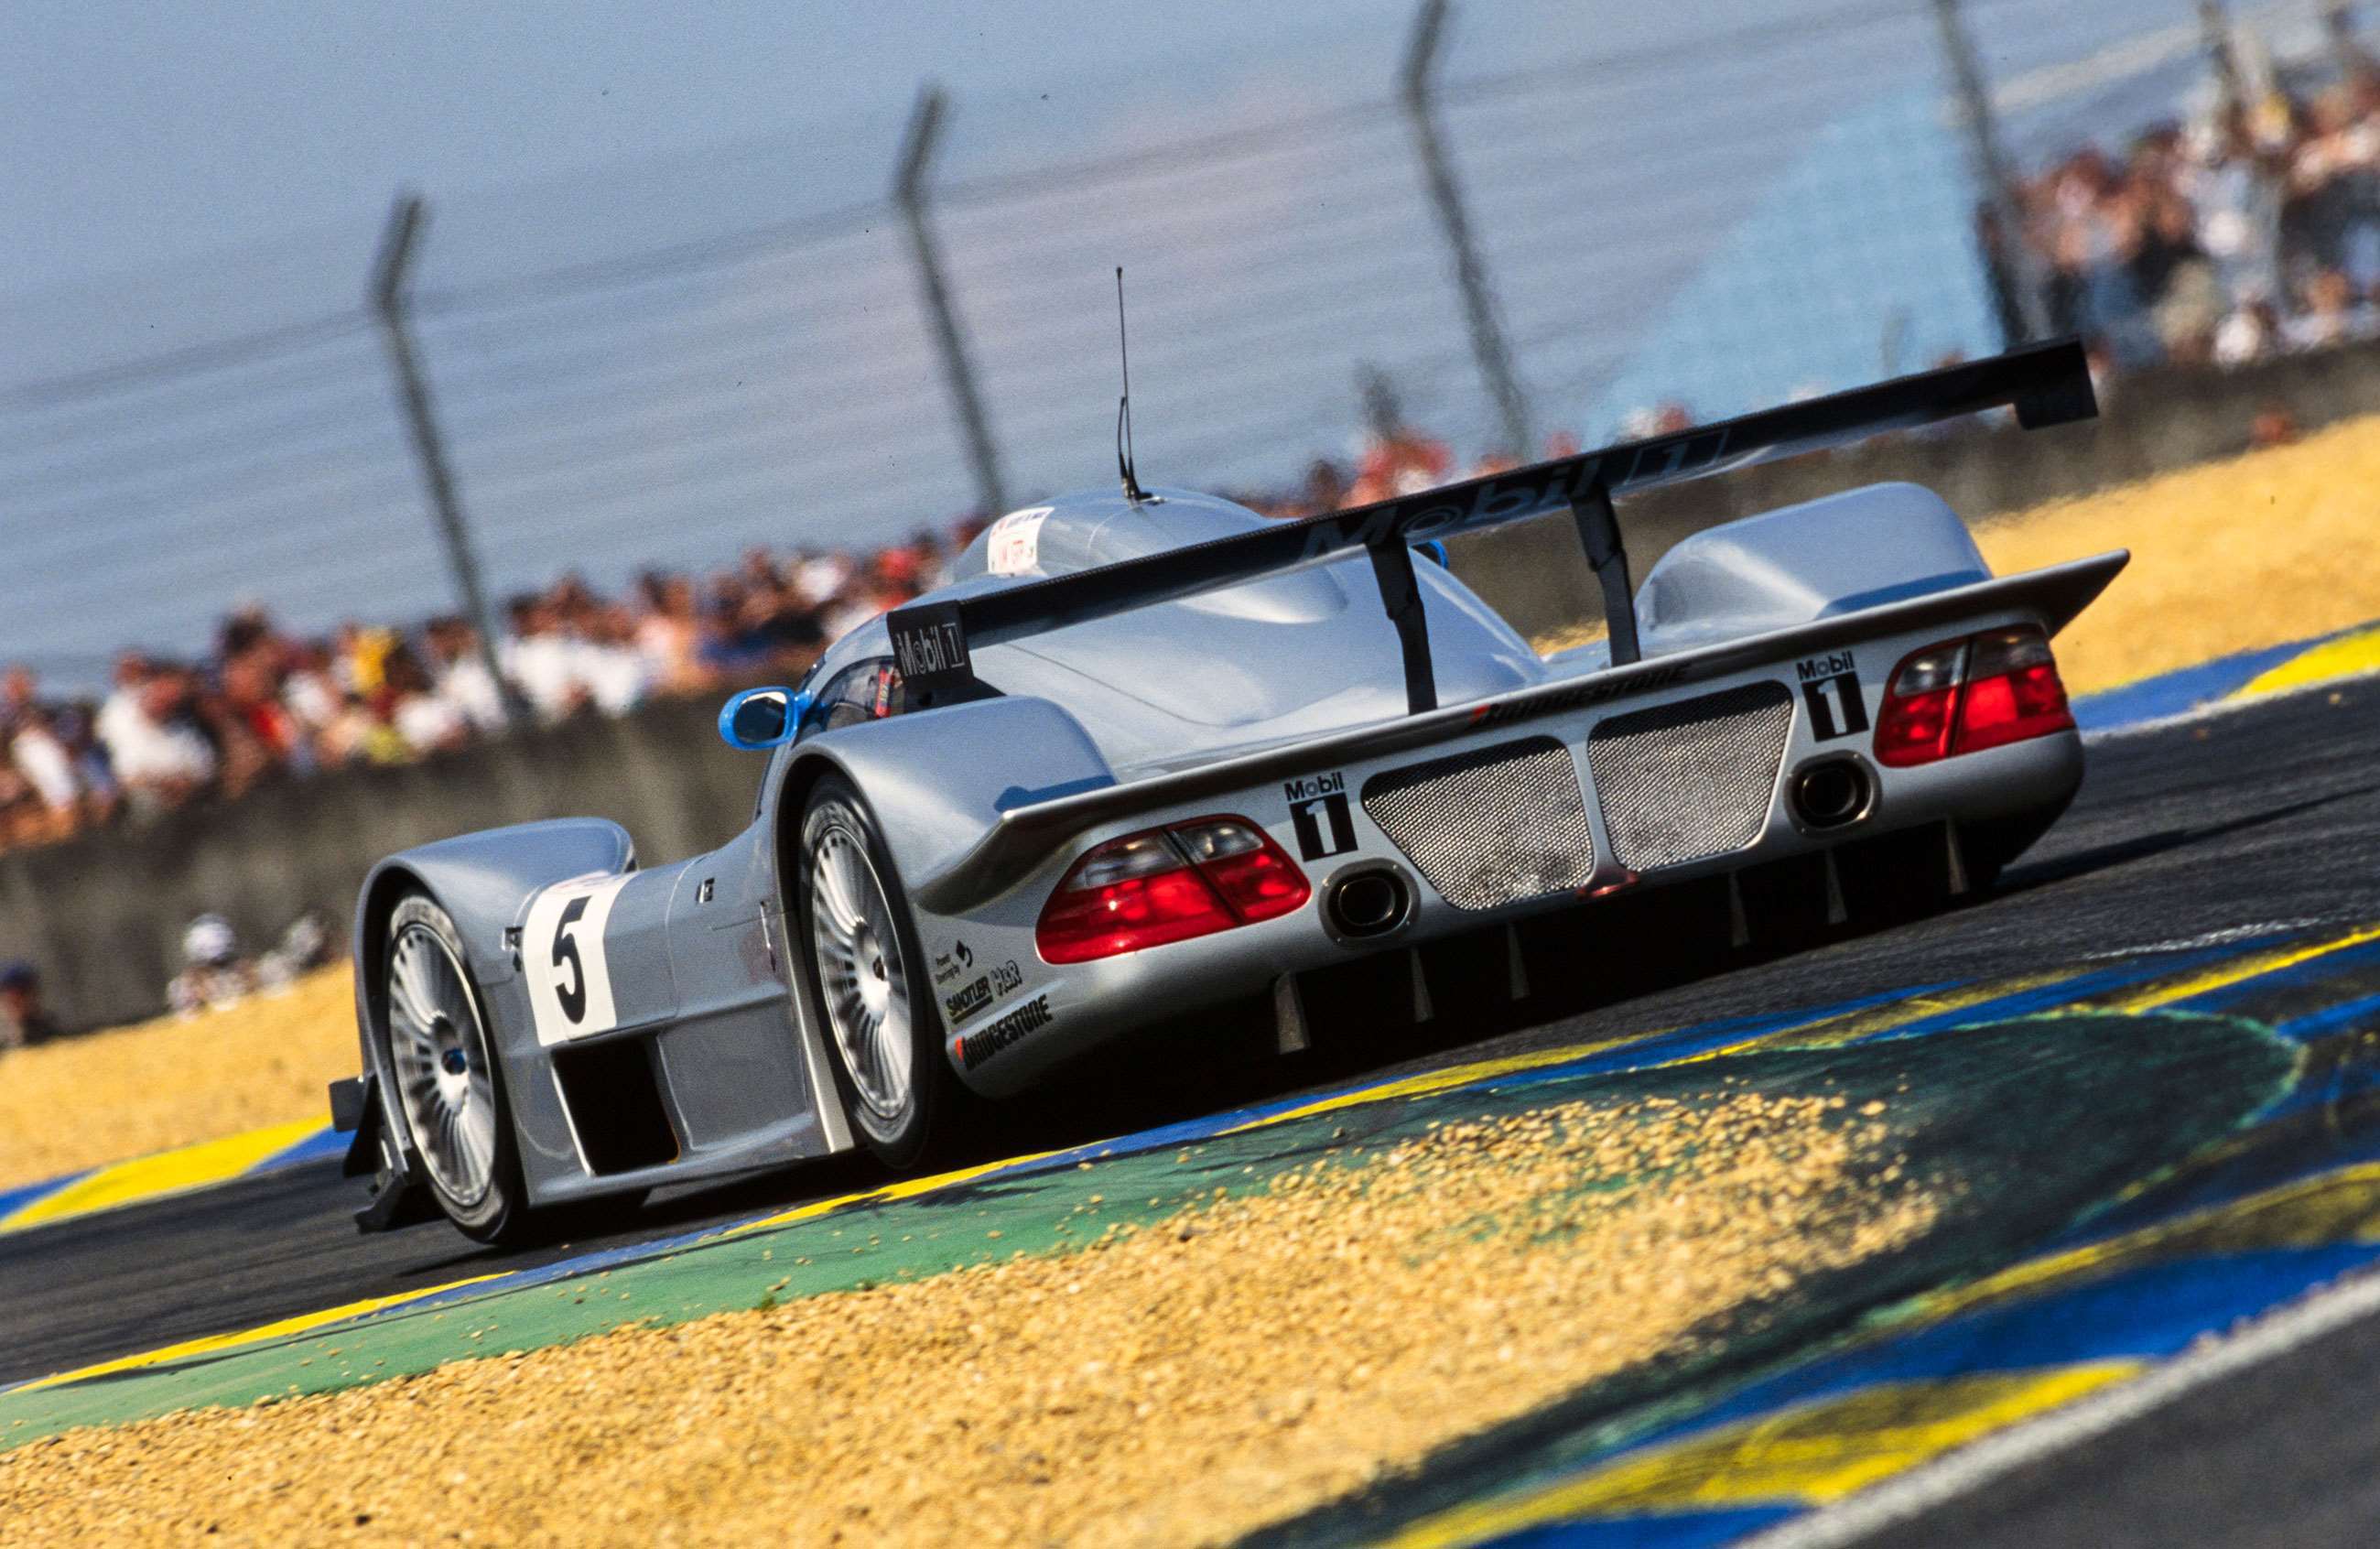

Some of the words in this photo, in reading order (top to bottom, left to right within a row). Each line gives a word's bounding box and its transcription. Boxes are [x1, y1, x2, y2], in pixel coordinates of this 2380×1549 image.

[1295, 456, 1600, 564] Mobil
[1651, 441, 1686, 470] 1
[895, 624, 947, 677] Mobil
[1796, 650, 1855, 682] Mobil
[1817, 678, 1848, 735] 1
[1283, 772, 1345, 802] Mobil
[1305, 800, 1337, 854] 1
[552, 894, 593, 1025] 5
